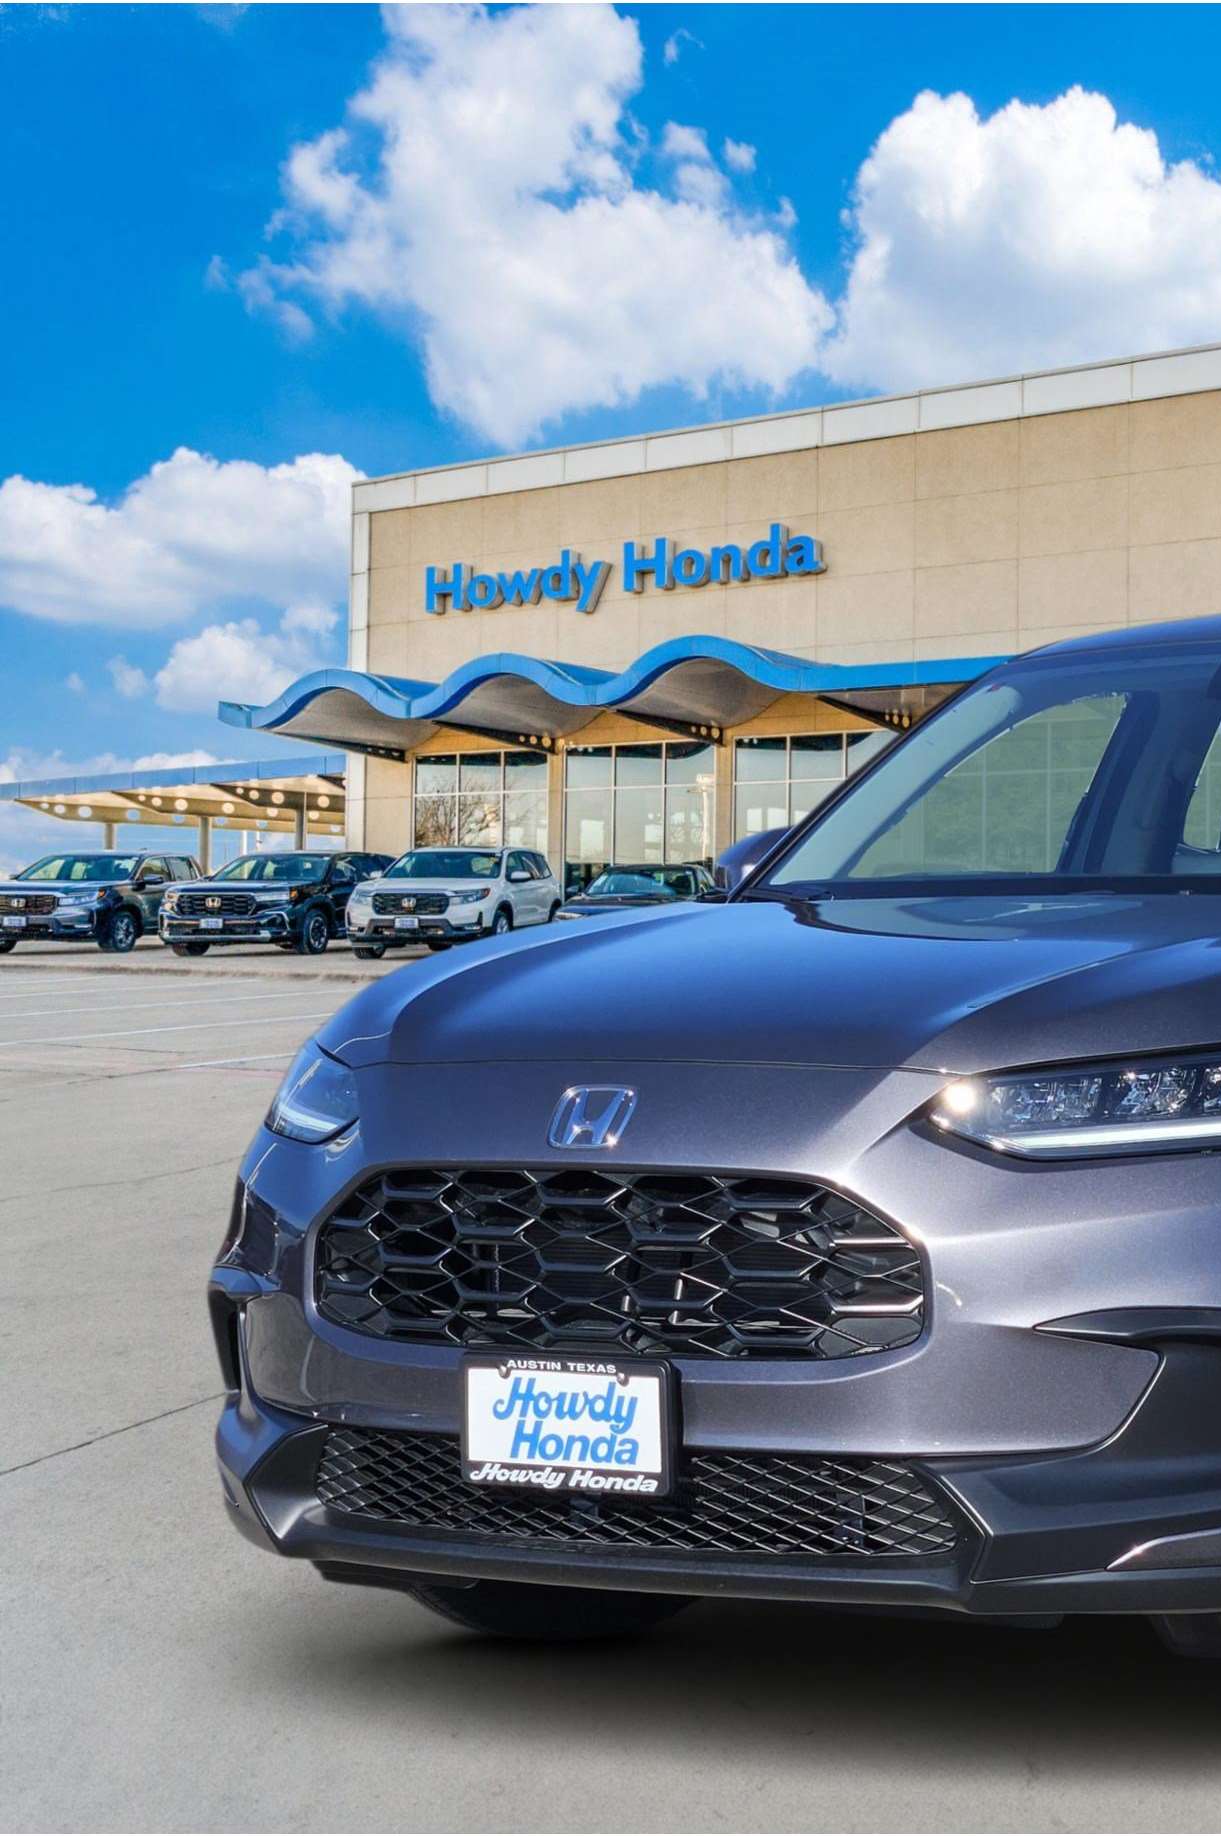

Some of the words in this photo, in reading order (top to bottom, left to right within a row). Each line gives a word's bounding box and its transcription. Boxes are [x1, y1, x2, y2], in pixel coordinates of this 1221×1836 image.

[424, 548, 613, 616] Howdy
[622, 522, 827, 595] Honda
[506, 1359, 562, 1371] AUSTIN
[567, 1362, 617, 1375] TEXAS
[492, 1376, 639, 1435] Howdy
[509, 1419, 640, 1466] Honda
[469, 1462, 566, 1489] Howdy
[568, 1469, 659, 1493] Honda
